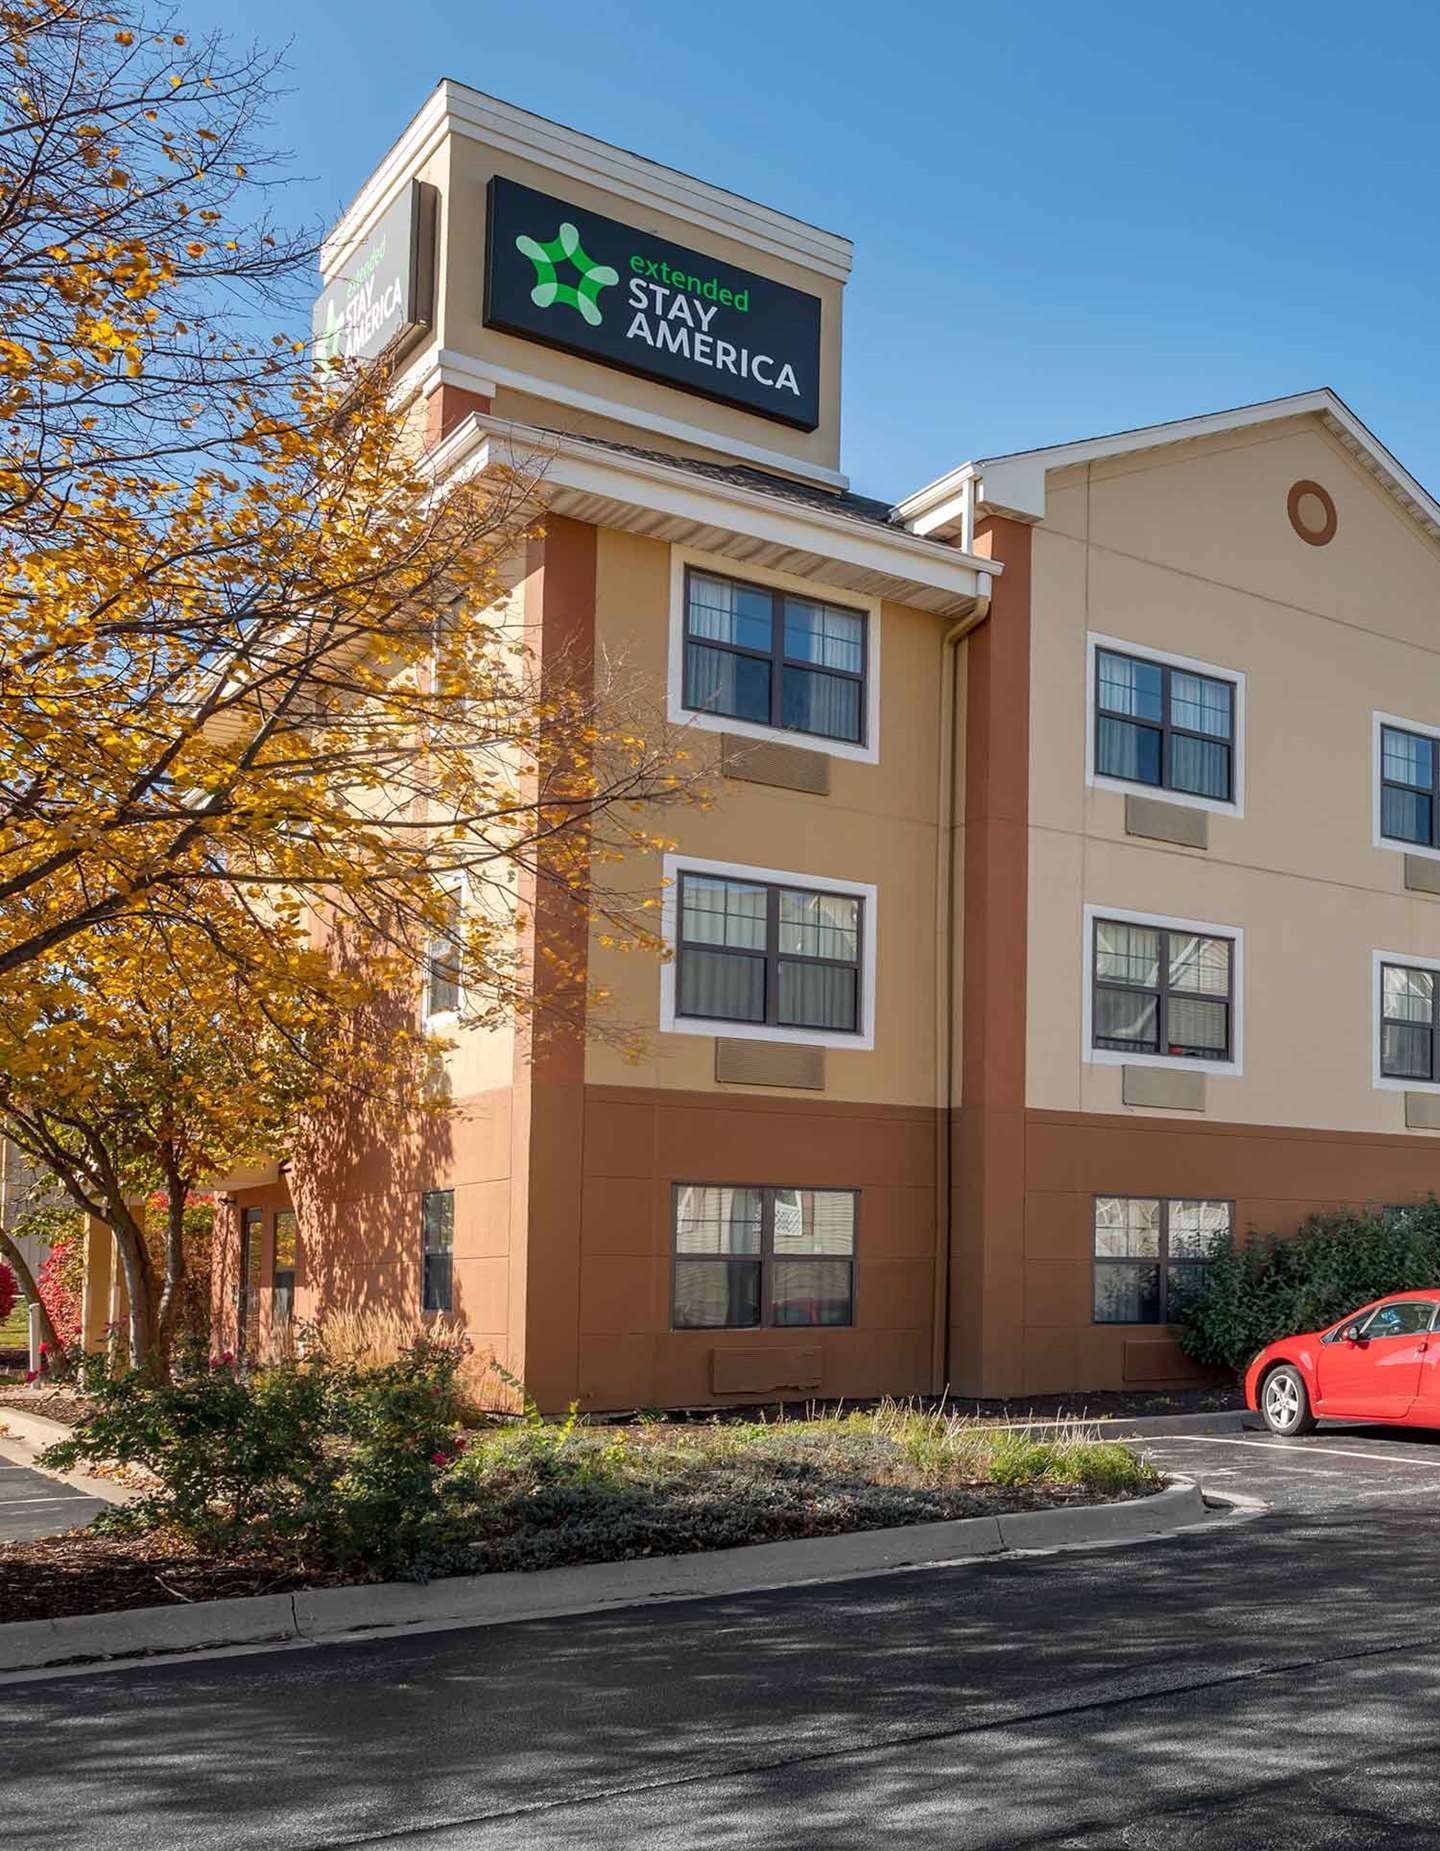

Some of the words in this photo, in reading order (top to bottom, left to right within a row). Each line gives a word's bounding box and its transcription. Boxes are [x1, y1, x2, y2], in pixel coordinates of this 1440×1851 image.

[346, 275, 375, 324] STAY
[628, 278, 718, 332] STAY
[630, 255, 748, 312] extended
[345, 277, 402, 359] AMERICA
[626, 312, 800, 396] AMERICA
